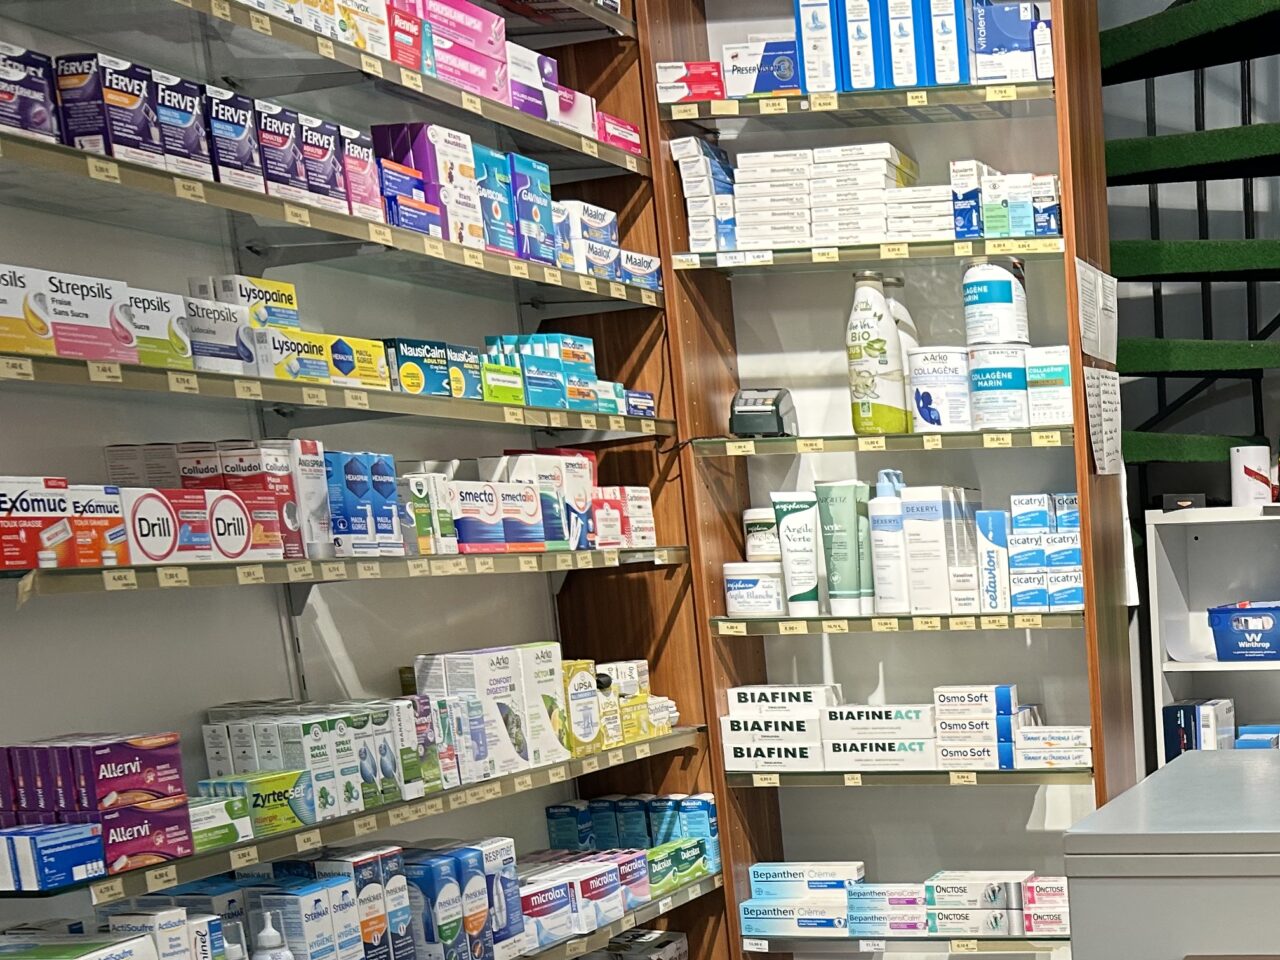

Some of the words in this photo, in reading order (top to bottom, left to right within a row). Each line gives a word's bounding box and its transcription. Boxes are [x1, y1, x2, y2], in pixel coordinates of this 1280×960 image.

[977, 5, 985, 51] vitalens
[58, 58, 97, 75] FERVEX
[105, 68, 148, 98] FERVEX
[158, 84, 200, 114] FERVEX
[212, 99, 252, 128] FERVEX
[260, 113, 295, 138] FERVEX
[582, 204, 608, 221] Maalox
[588, 242, 613, 260] Maalox
[625, 253, 654, 270] Maalox
[48, 276, 112, 300] Strepsils
[239, 283, 293, 305] Lysopaïne
[128, 295, 171, 314] repsils
[187, 302, 238, 323] Strepsils
[272, 336, 324, 356] Lysopaïne
[400, 343, 446, 358] NausiCalm
[447, 348, 478, 364] NausiCalm
[929, 353, 948, 362] Arko
[914, 366, 959, 376] COLLAGÈNE
[972, 371, 1013, 382] COLLAGÈNE
[978, 379, 1003, 388] MARIN
[181, 463, 219, 475] Colludol
[224, 461, 261, 473] Colludol
[265, 462, 290, 473] Colludol
[0, 490, 67, 516] Exomuc
[459, 490, 494, 503] smecta
[1012, 496, 1045, 507] cicatryl
[73, 499, 120, 516] Exomuc
[905, 505, 938, 514] DEXERYL
[138, 518, 171, 537] Drill
[215, 518, 245, 537] Drill
[873, 518, 900, 526] DEXERYL
[783, 525, 814, 537] Argile
[785, 534, 811, 544] Verte
[1009, 535, 1042, 547] cicatryl
[1046, 534, 1078, 546] cicatryl
[988, 550, 998, 609] cetavlon
[1012, 574, 1045, 586] cicatryl
[1239, 640, 1270, 649] Winthrop
[574, 682, 592, 692] UPSA
[737, 691, 813, 703] BIAFINE
[938, 693, 964, 703] Osmo
[967, 692, 989, 703] Soft
[730, 720, 806, 732] BIAFINE
[940, 721, 965, 731] Osmo
[967, 720, 990, 731] Soft
[310, 744, 327, 752] SPRAY
[732, 747, 809, 759] BIAFINE
[941, 748, 966, 759] Osmo
[968, 748, 991, 758] Soft
[98, 757, 141, 779] Allervi
[108, 820, 150, 843] Allervi
[681, 847, 700, 859] Dulcolax
[620, 857, 646, 874] microlax
[652, 858, 672, 873] Dulcolax
[590, 871, 617, 889] microlax
[753, 870, 804, 882] Bepanthen
[807, 869, 837, 880] Crème
[935, 885, 968, 895] ONCTOSE
[1035, 884, 1064, 894] ONCTOSE
[531, 888, 567, 906] microlax
[743, 907, 795, 919] Bepanthen
[797, 906, 827, 918] Crème
[937, 911, 970, 922] ONCTOSE
